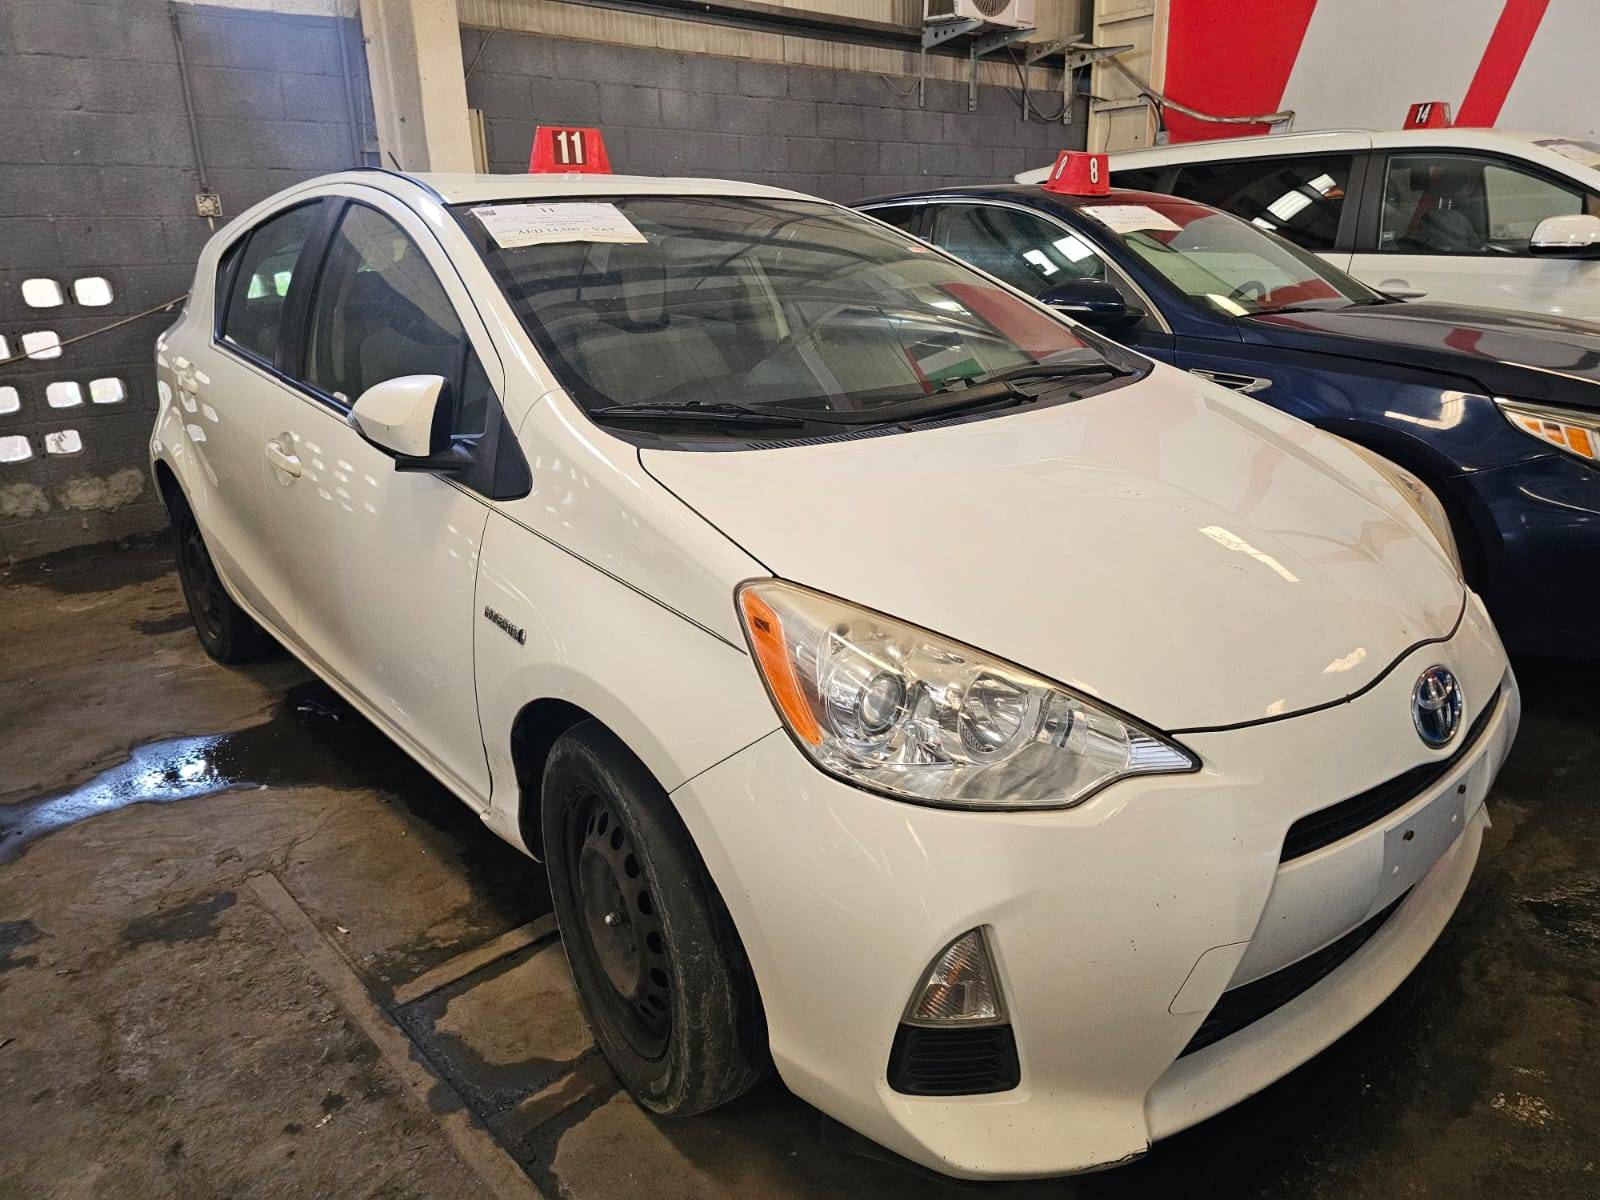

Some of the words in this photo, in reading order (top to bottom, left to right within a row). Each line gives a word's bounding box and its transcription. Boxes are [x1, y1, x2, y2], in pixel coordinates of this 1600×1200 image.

[1415, 103, 1432, 123] 14
[557, 131, 583, 164] 11
[1089, 157, 1098, 184] 8
